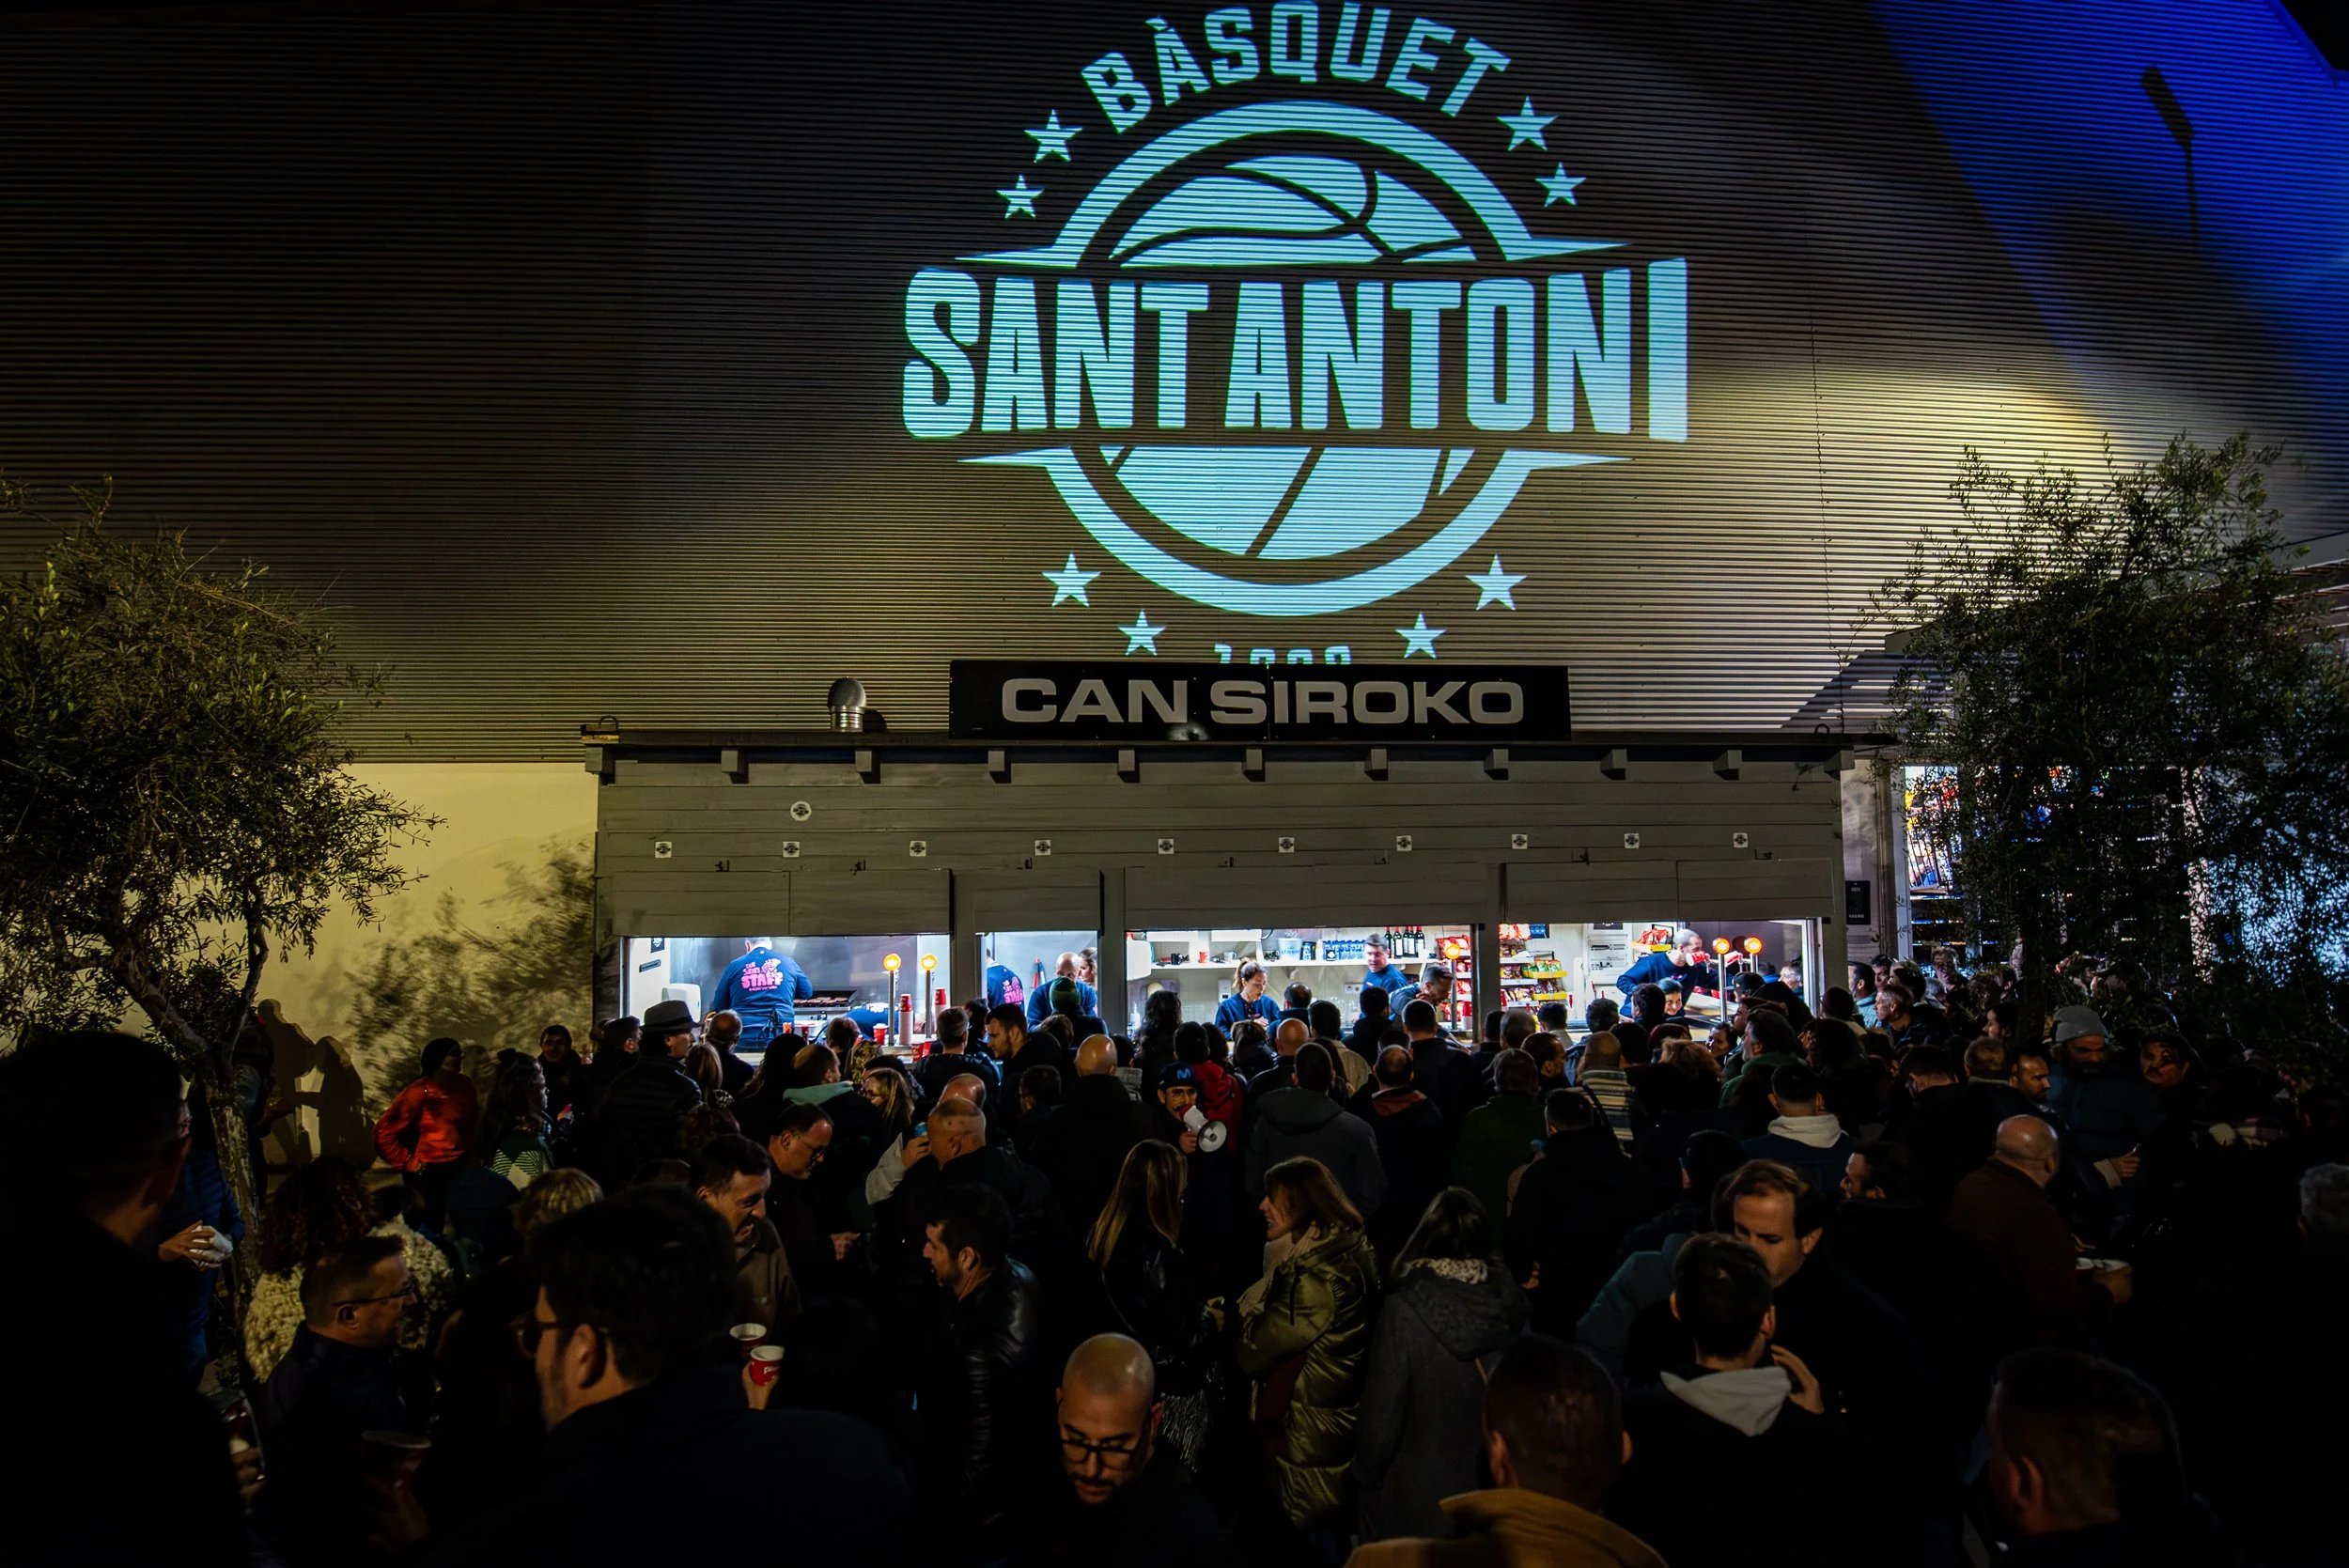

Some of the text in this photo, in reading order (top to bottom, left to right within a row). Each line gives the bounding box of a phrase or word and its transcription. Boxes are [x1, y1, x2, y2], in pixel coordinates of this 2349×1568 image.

[1081, 1, 1510, 134] BÀSQUET
[903, 257, 1688, 442] SANT ANTONI
[1002, 678, 1524, 724] CAN SIROKO
[741, 972, 783, 988] STAFF
